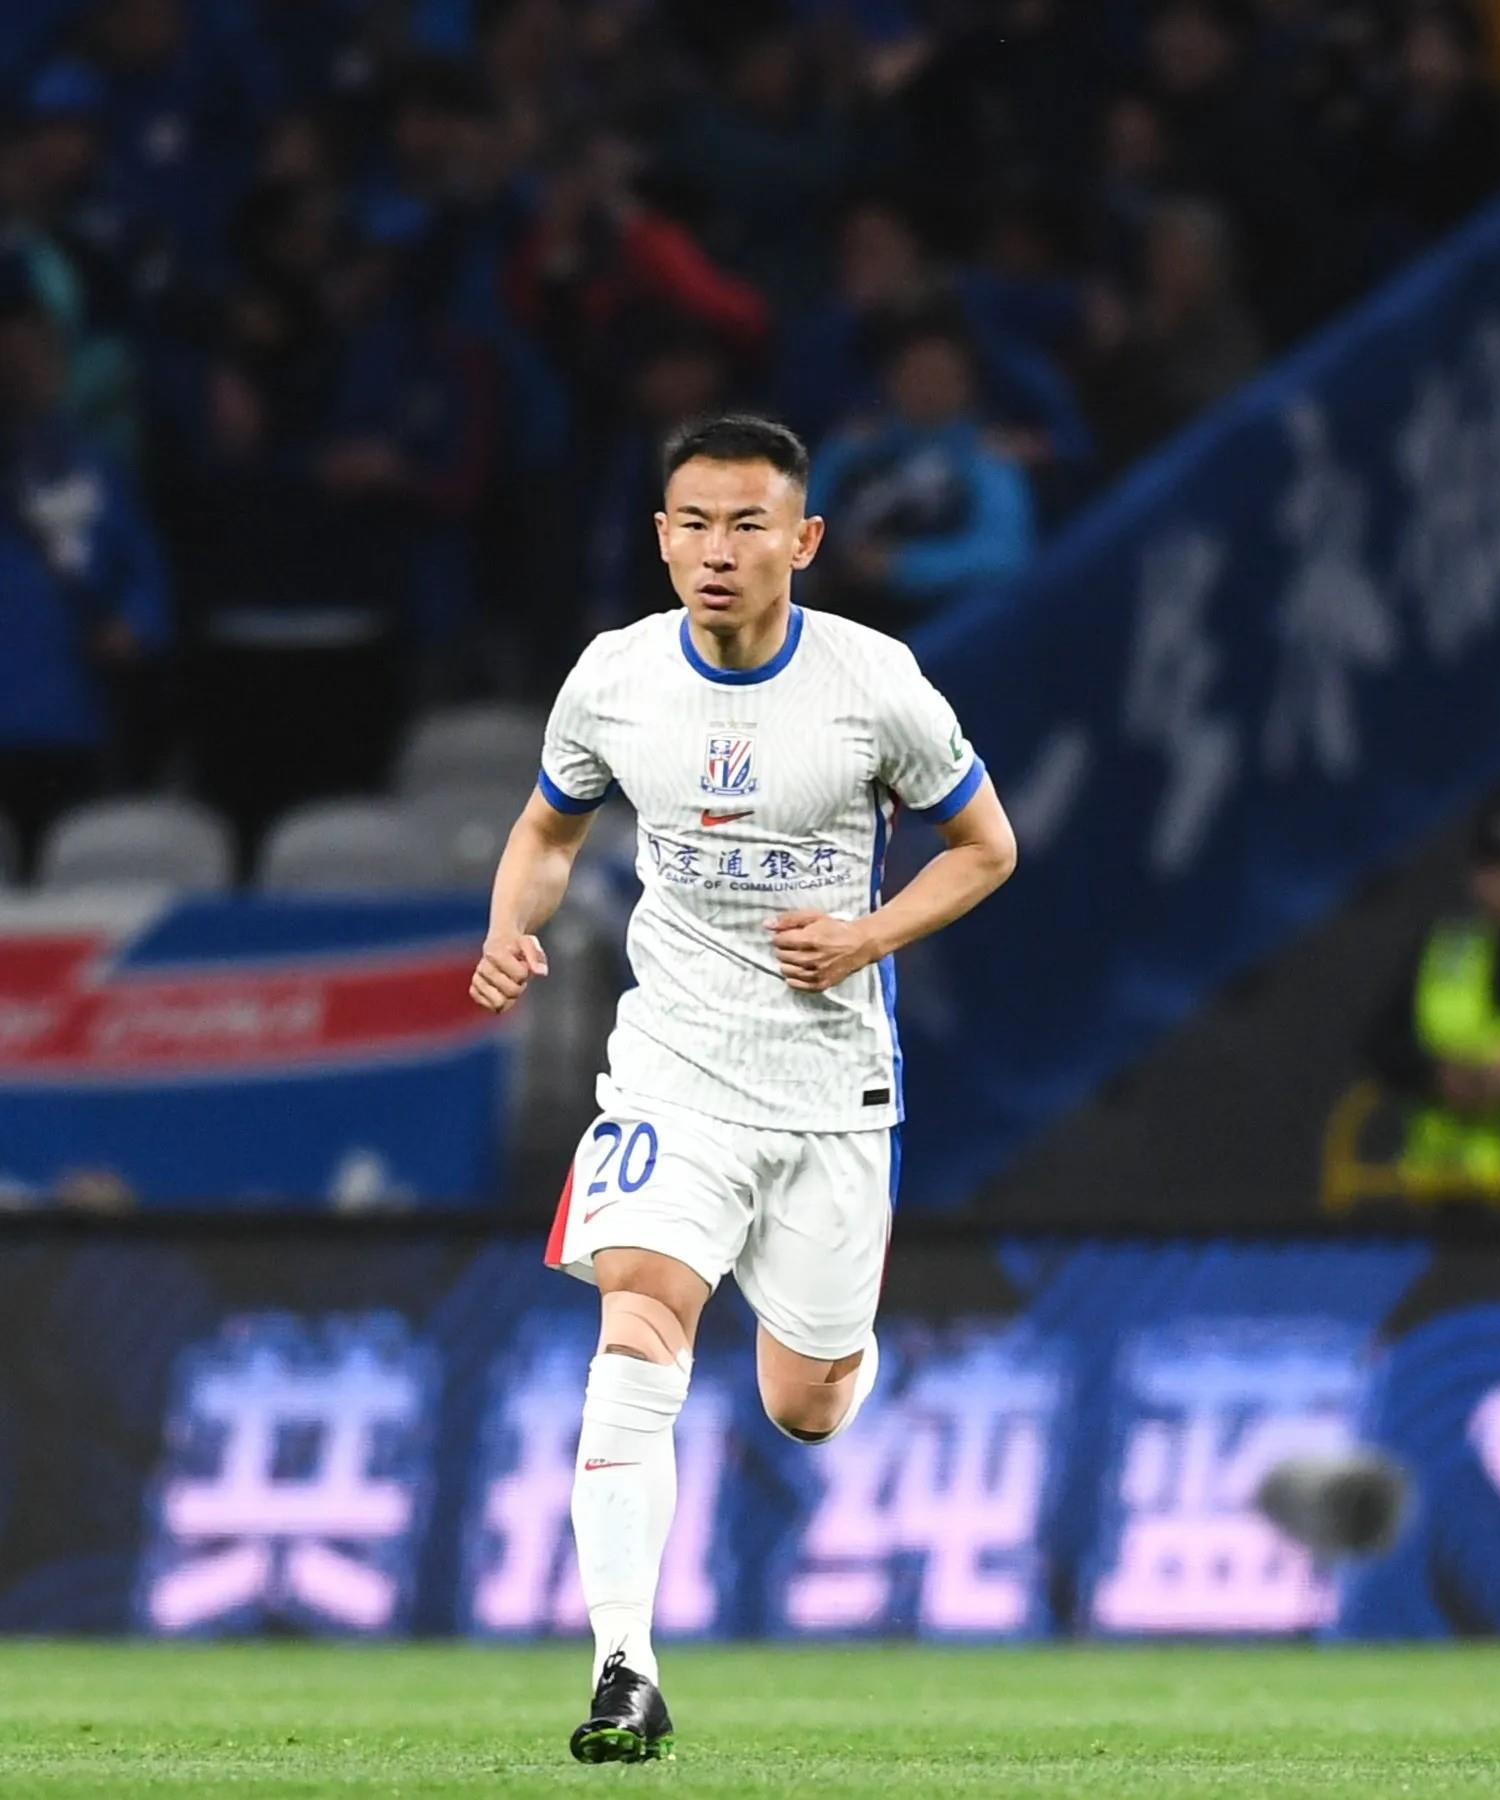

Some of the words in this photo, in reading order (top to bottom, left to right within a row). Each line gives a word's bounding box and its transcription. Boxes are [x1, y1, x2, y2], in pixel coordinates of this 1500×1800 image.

[674, 847, 838, 879] 交通銀行
[665, 872, 697, 884] BANK
[703, 880, 722, 890] OF
[587, 1121, 658, 1197] 20
